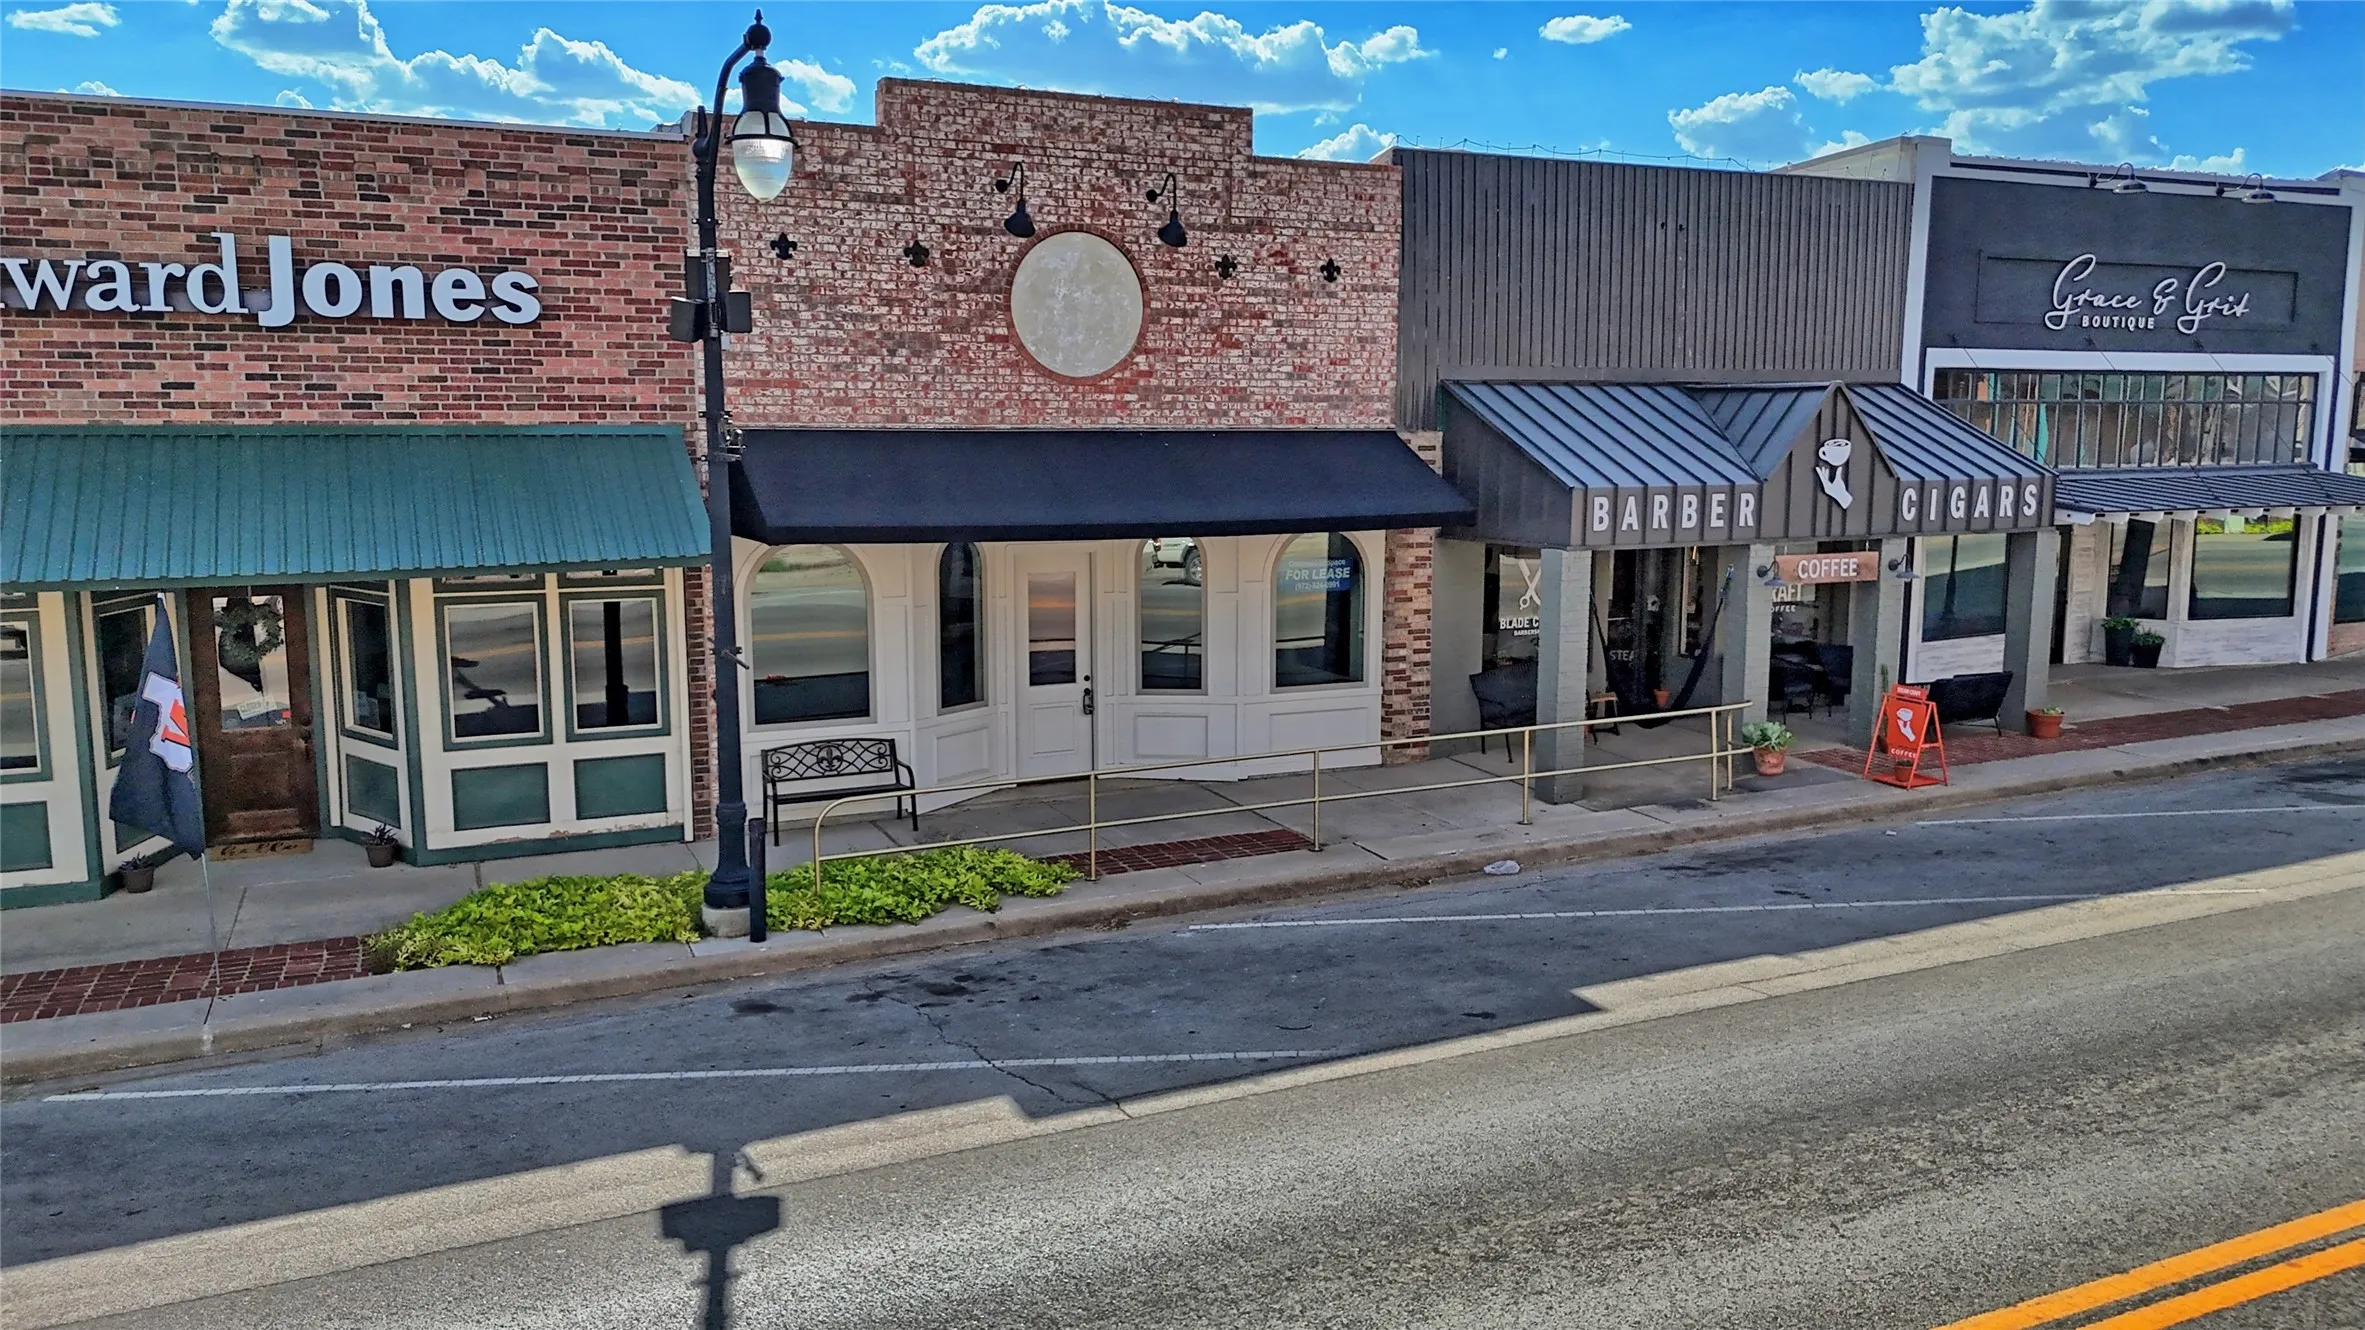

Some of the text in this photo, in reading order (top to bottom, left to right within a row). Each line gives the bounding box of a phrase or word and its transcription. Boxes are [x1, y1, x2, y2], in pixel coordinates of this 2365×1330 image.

[0, 232, 542, 328] ward Jones
[2044, 253, 2250, 335] Grace & Grit
[2081, 314, 2155, 331] BOUTIQUE
[1592, 492, 1755, 532] BARBER
[1902, 484, 2038, 521] CIGARS
[1285, 566, 1351, 580] FOR LEASE
[1798, 557, 1859, 579] COFFEE
[1770, 604, 1797, 613] OFFEE
[1499, 616, 1530, 630] BLADE
[1513, 629, 1540, 637] BARBERS
